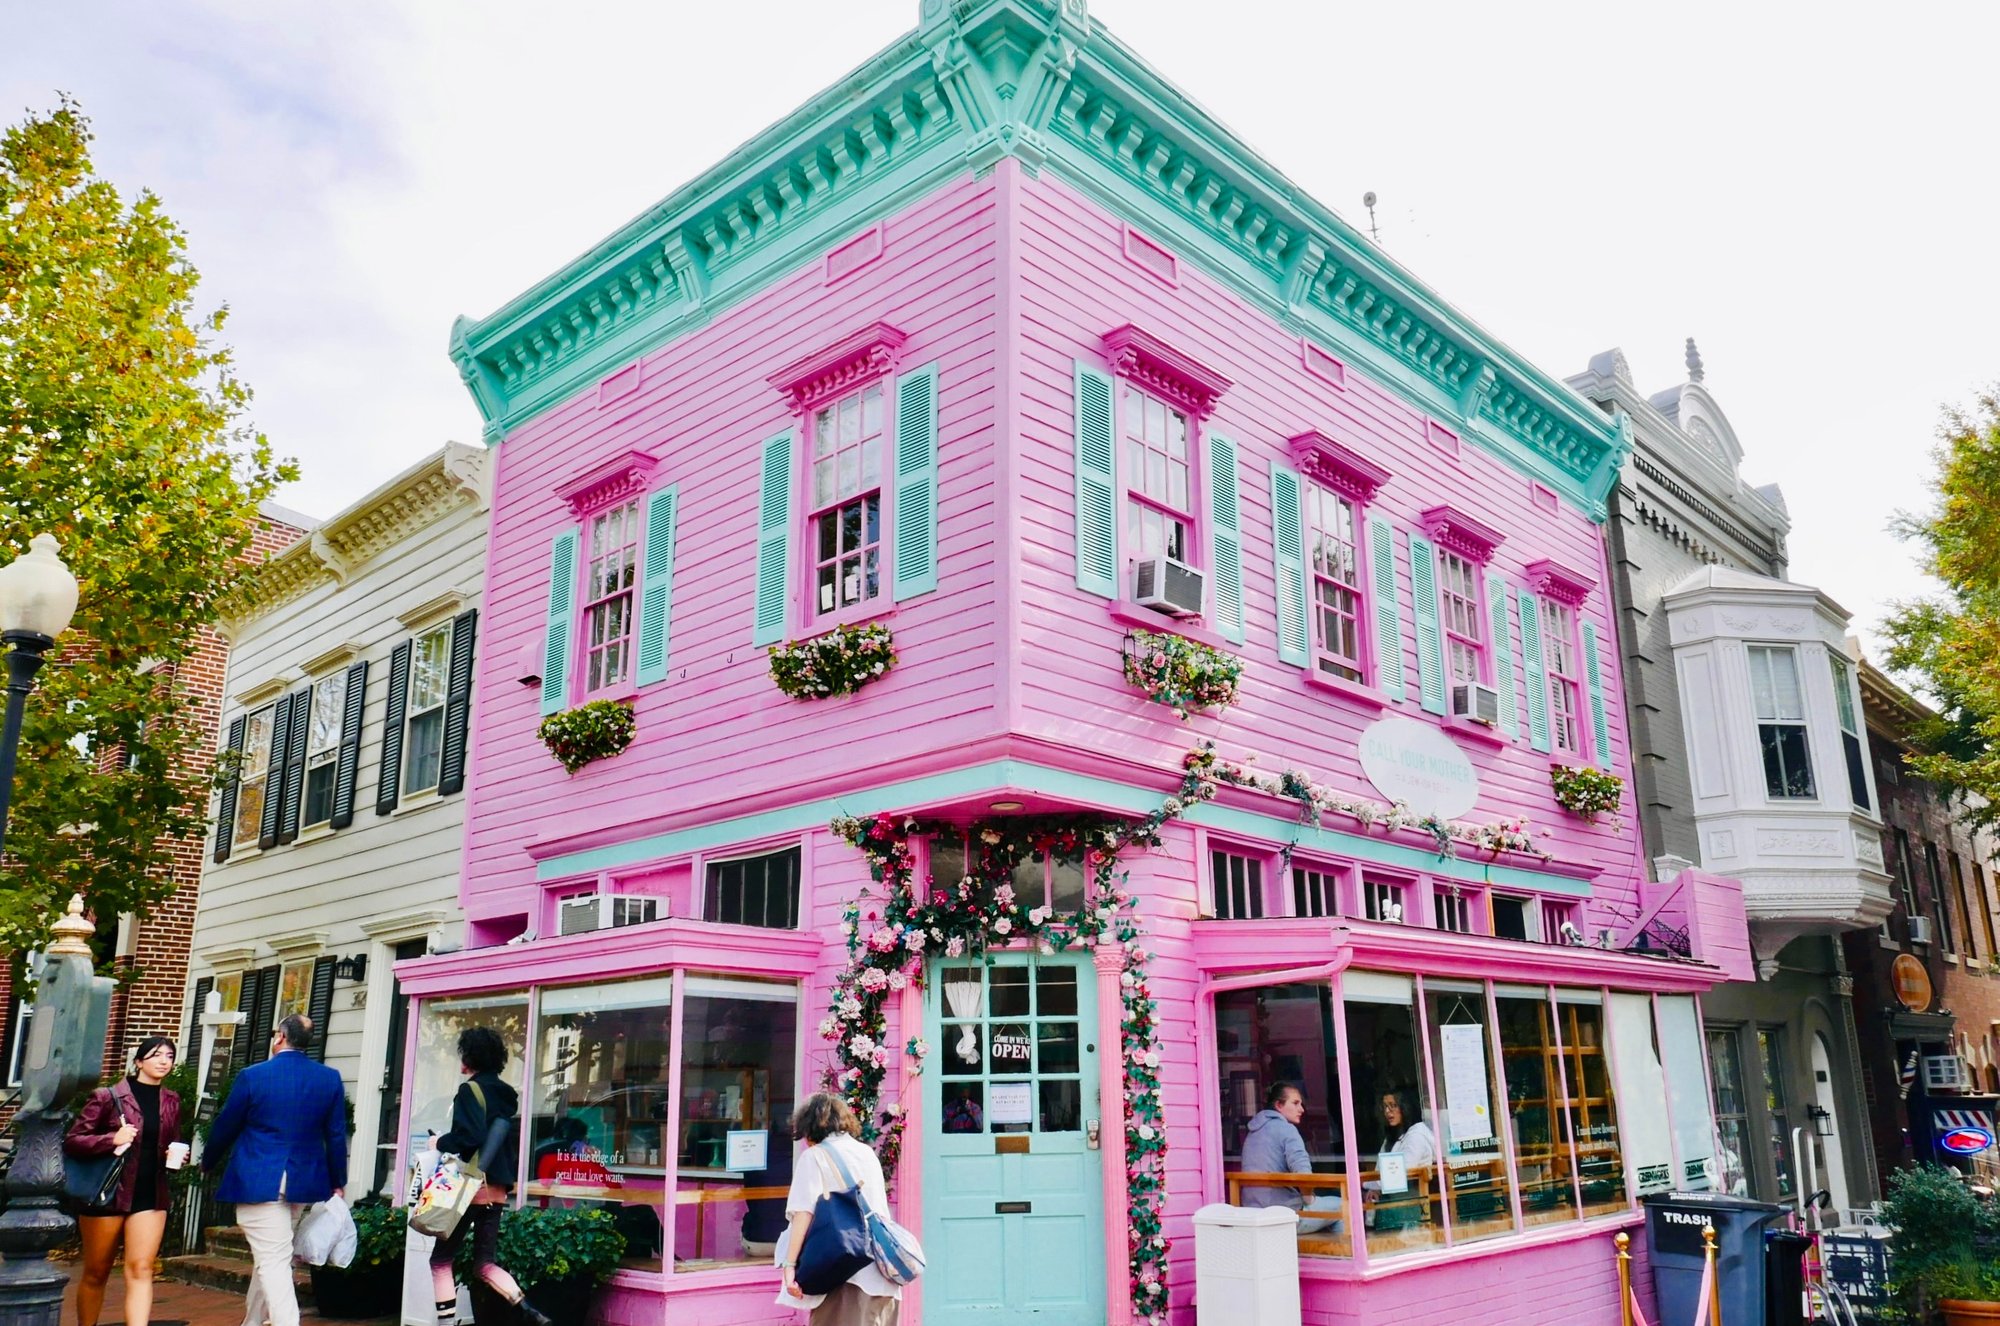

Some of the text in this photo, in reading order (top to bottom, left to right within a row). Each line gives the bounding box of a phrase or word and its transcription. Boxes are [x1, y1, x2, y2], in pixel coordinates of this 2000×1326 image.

[1367, 739, 1470, 783] CALL YOUR MOTHER
[992, 1043, 1031, 1059] OPEN
[1463, 1139, 1474, 1149] and
[1475, 1139, 1479, 1148] a
[1480, 1138, 1489, 1147] red
[557, 1148, 624, 1167] It is at the edge of a
[556, 1168, 626, 1183] petal that love waits.
[1663, 1212, 1712, 1226] TRASH
